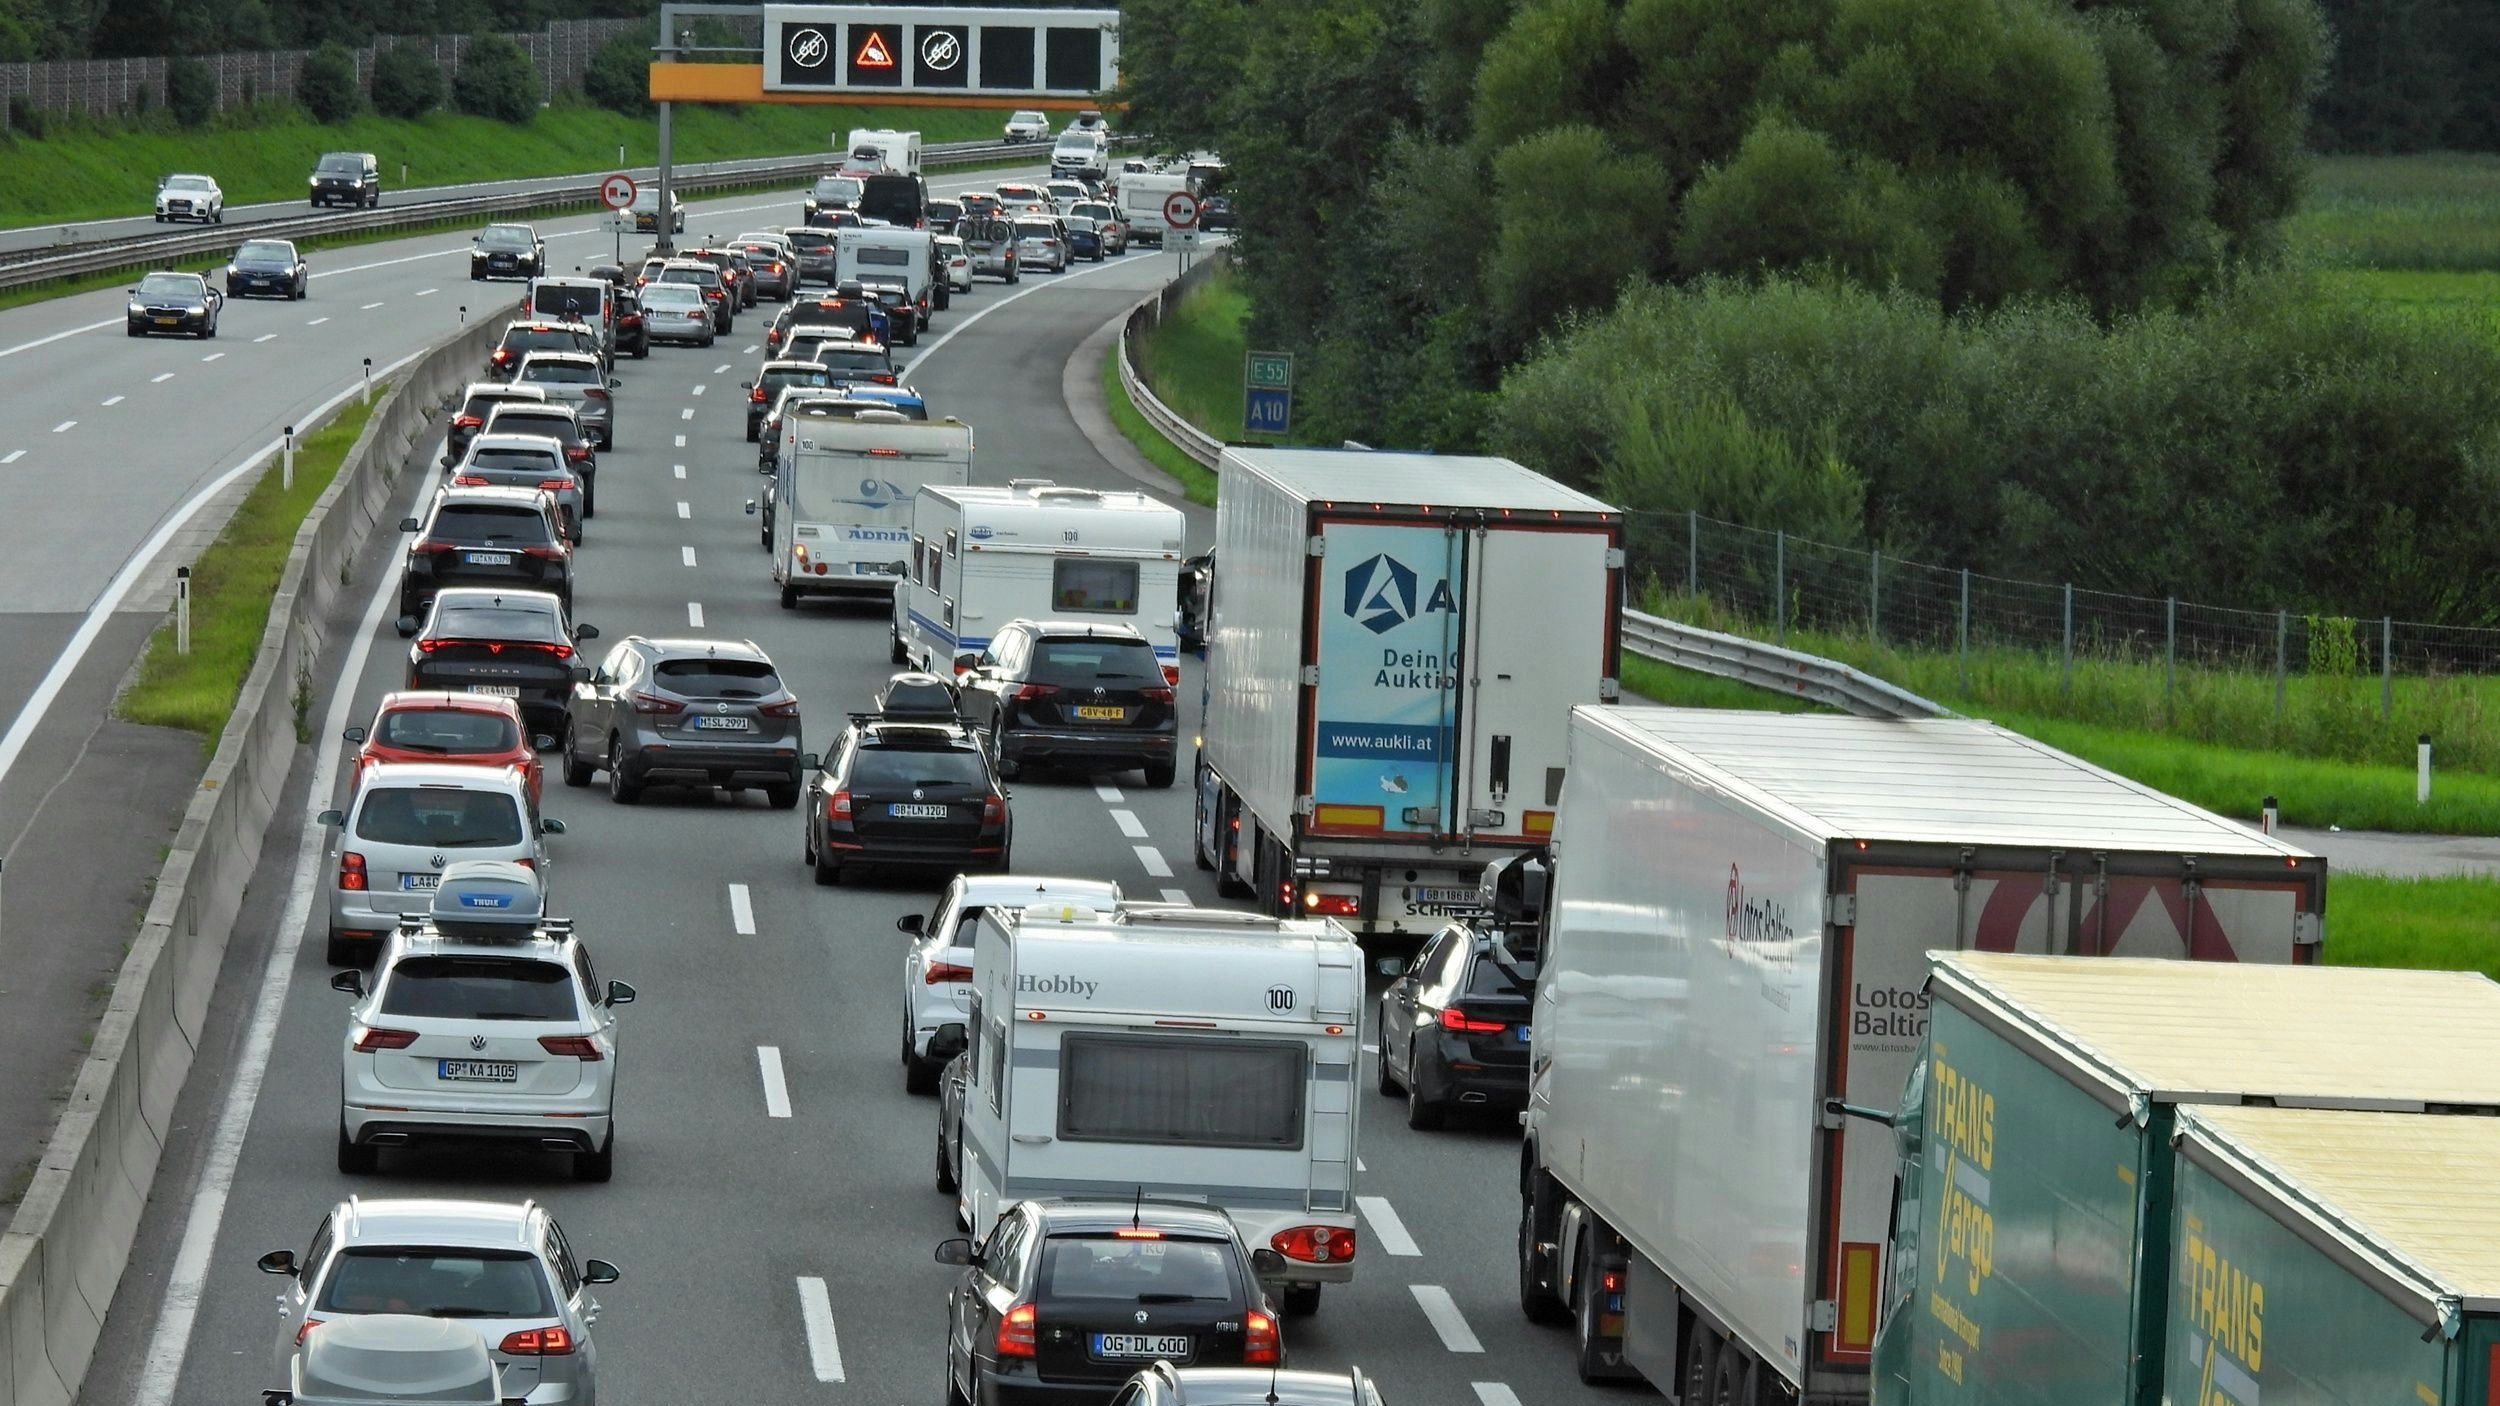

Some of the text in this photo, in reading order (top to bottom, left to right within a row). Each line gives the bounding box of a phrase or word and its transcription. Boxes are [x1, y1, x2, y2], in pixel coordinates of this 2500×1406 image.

[1254, 362, 1284, 380] E 55
[1251, 400, 1283, 421] A 10
[848, 529, 910, 542] ADRIA
[1063, 531, 1078, 541] 100
[1384, 649, 1438, 669] Dein
[712, 717, 724, 728] SL
[725, 718, 748, 729] 2991
[1332, 734, 1432, 751] www.aukli.at
[894, 804, 946, 817] BB LN 1201
[411, 875, 426, 888] LA
[473, 898, 499, 907] THULE
[1018, 974, 1099, 1000] Hobby
[1856, 983, 1930, 1009] Lotos
[1268, 989, 1293, 1009] 100
[446, 1062, 515, 1078] GP KA 1105
[1935, 1059, 1994, 1171] TRANS
[2189, 1234, 2264, 1373] TRANS
[1103, 1335, 1187, 1353] OG DL 600
